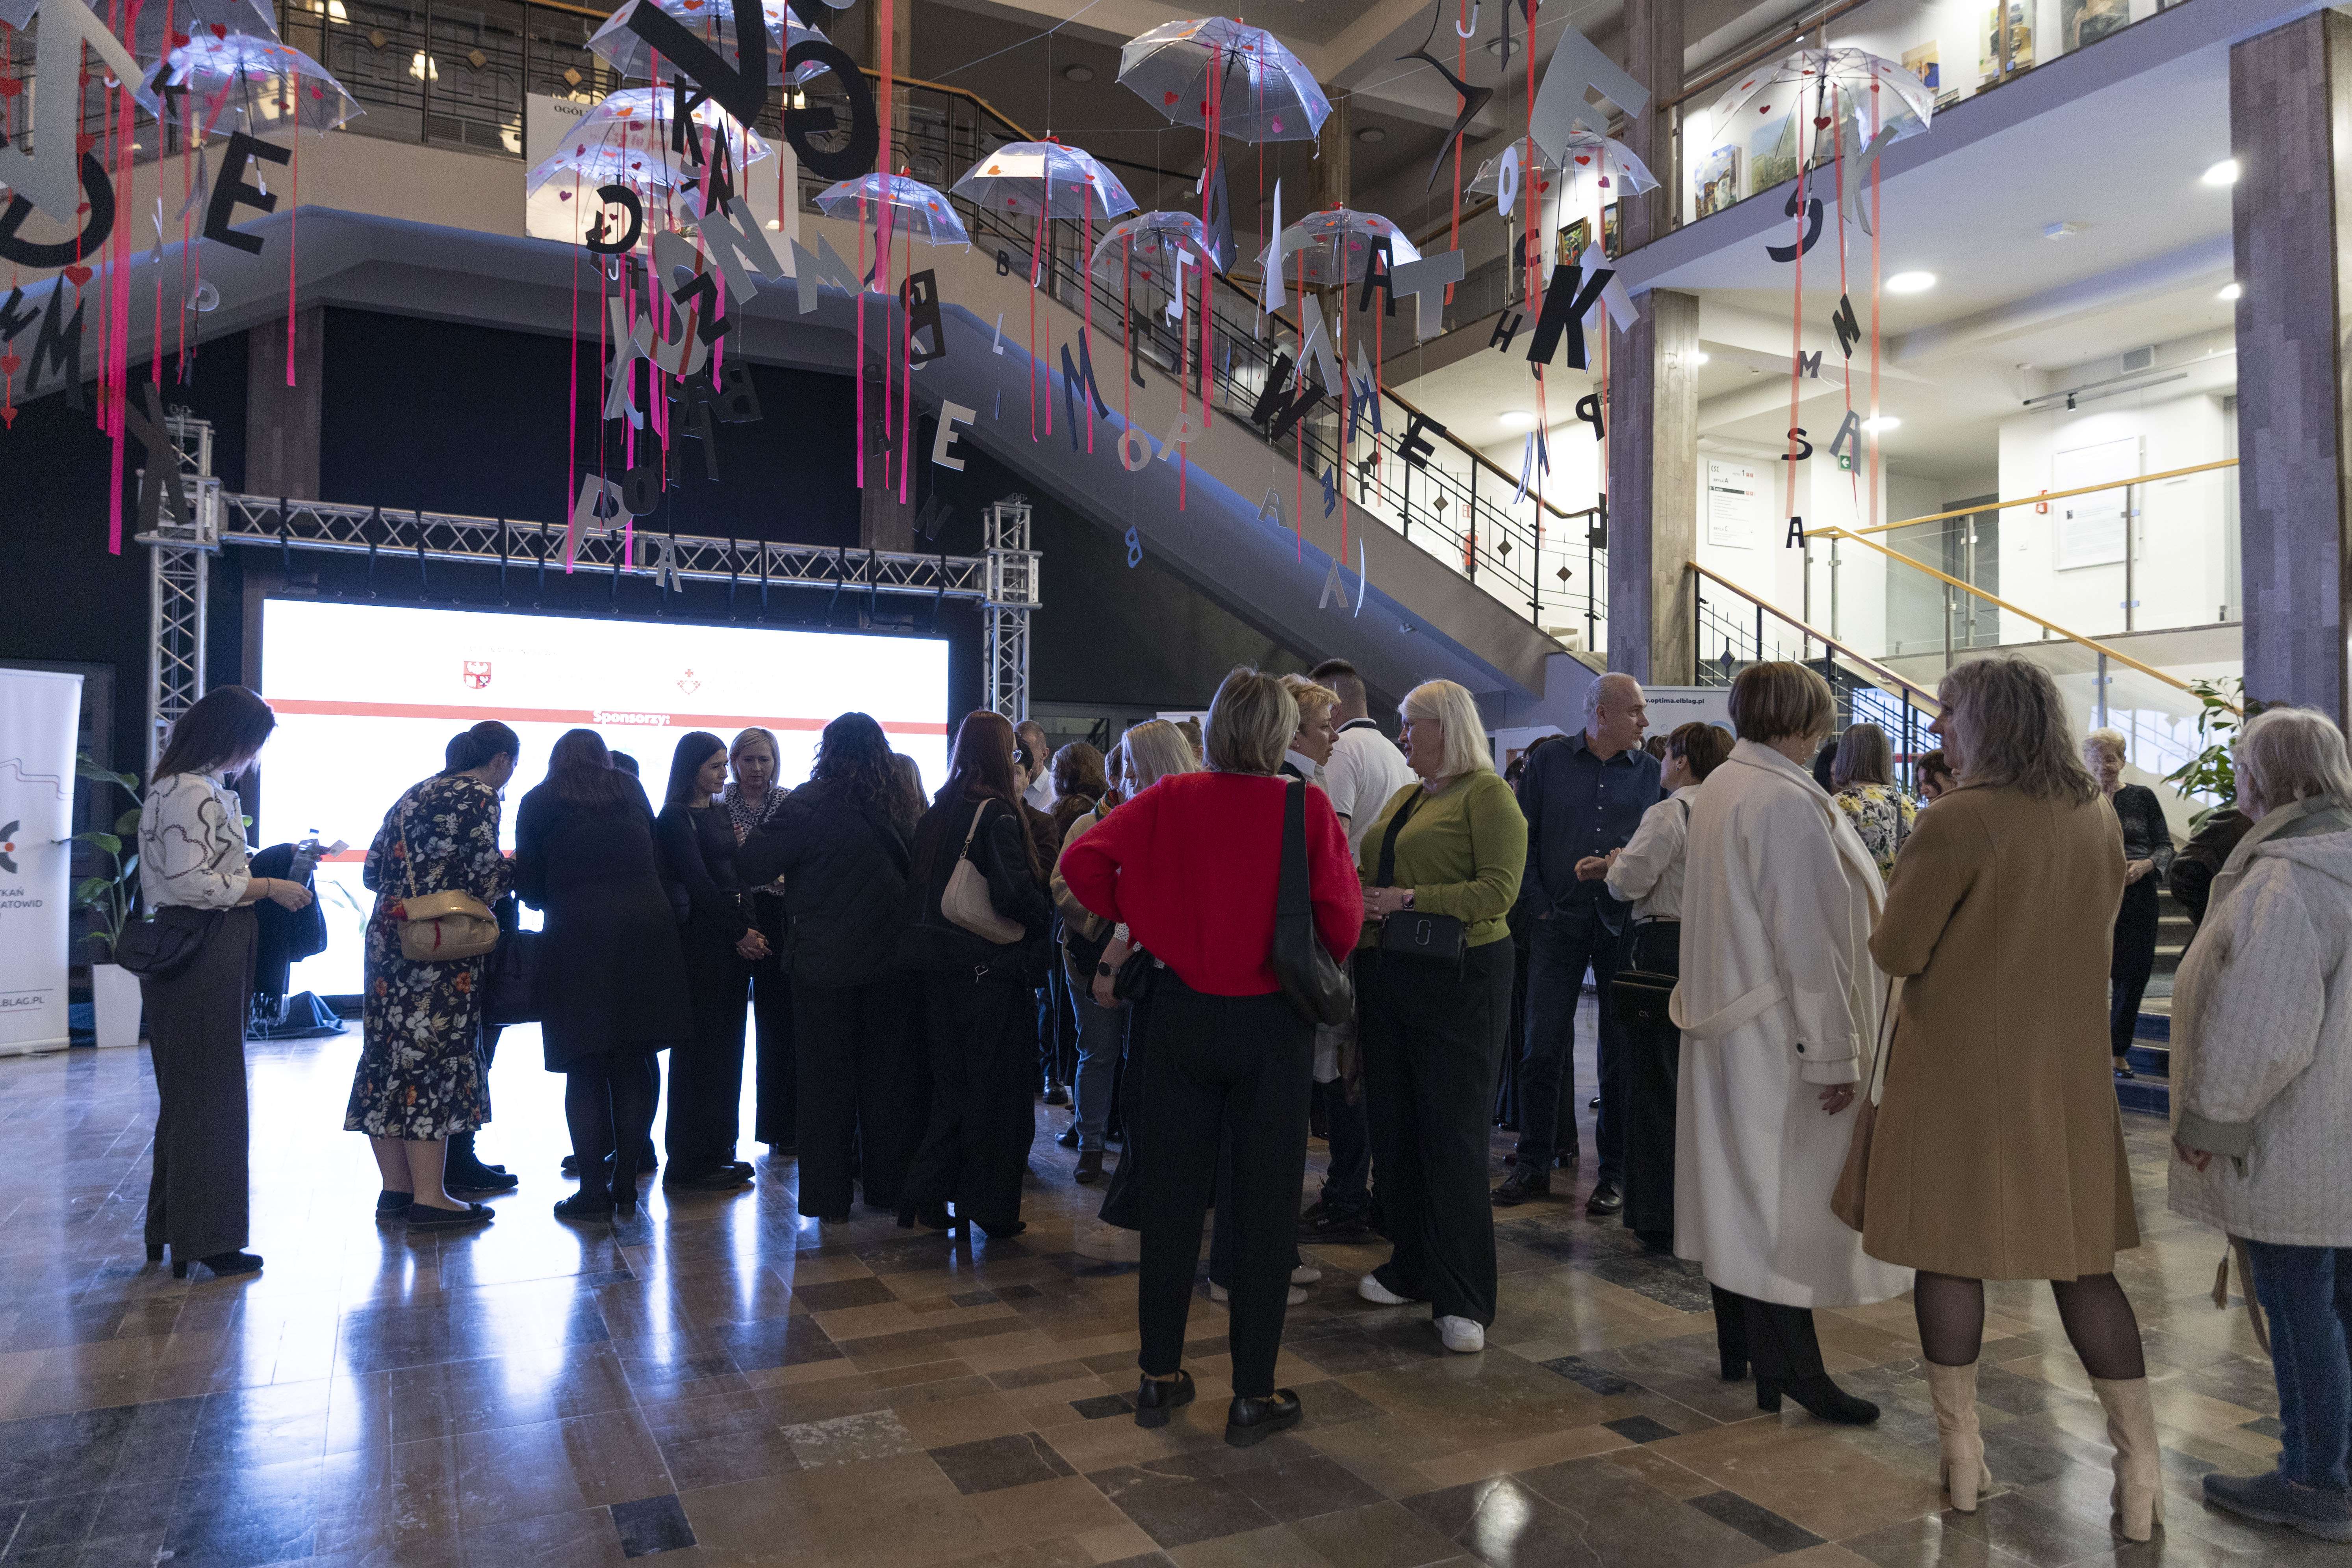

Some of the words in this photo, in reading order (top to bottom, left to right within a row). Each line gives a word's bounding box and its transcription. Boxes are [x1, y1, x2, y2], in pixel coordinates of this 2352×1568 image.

[554, 104, 590, 117] OGÓL
[204, 131, 292, 255] E
[996, 249, 1010, 276] B
[1359, 235, 1395, 317] A
[1390, 249, 1464, 341] T
[1526, 264, 1616, 371] K
[1488, 309, 1523, 353] H
[1797, 351, 1823, 378] M
[932, 399, 977, 471] E
[1117, 429, 1152, 471] O
[1157, 411, 1202, 461] P
[1396, 416, 1447, 470] E
[1781, 428, 1812, 460] S
[1829, 409, 1861, 477] A
[555, 473, 634, 567] P
[1257, 487, 1288, 529] A
[1786, 516, 1805, 548] A
[655, 538, 682, 592] A
[1318, 558, 1349, 609] A
[593, 709, 670, 726] Sponsorzy:
